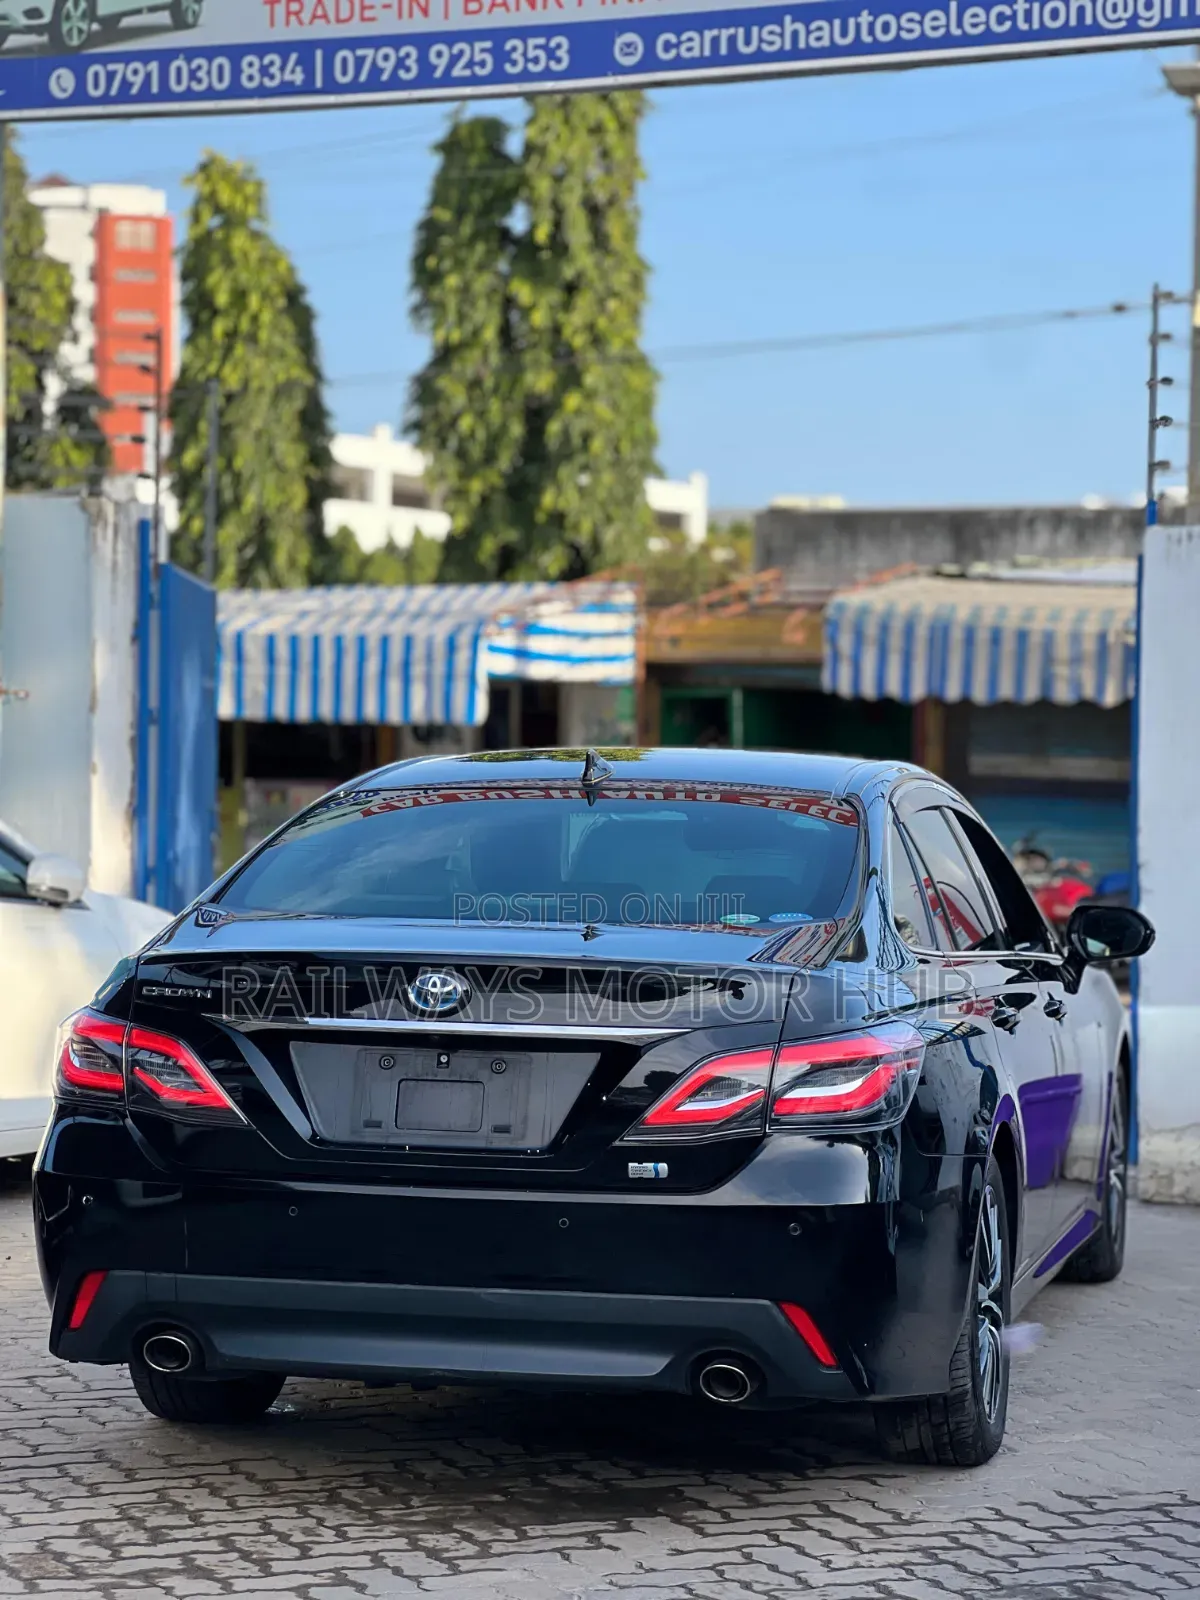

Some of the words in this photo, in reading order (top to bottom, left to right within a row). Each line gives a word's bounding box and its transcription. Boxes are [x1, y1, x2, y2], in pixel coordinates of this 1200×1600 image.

[263, 0, 429, 29] TRADE-IN
[86, 61, 159, 98] 0791
[168, 55, 231, 93] 030
[240, 52, 304, 89] 834
[333, 46, 419, 84] 0793
[428, 41, 494, 78] 925
[504, 35, 569, 74] 353
[142, 986, 212, 999] CROWN
